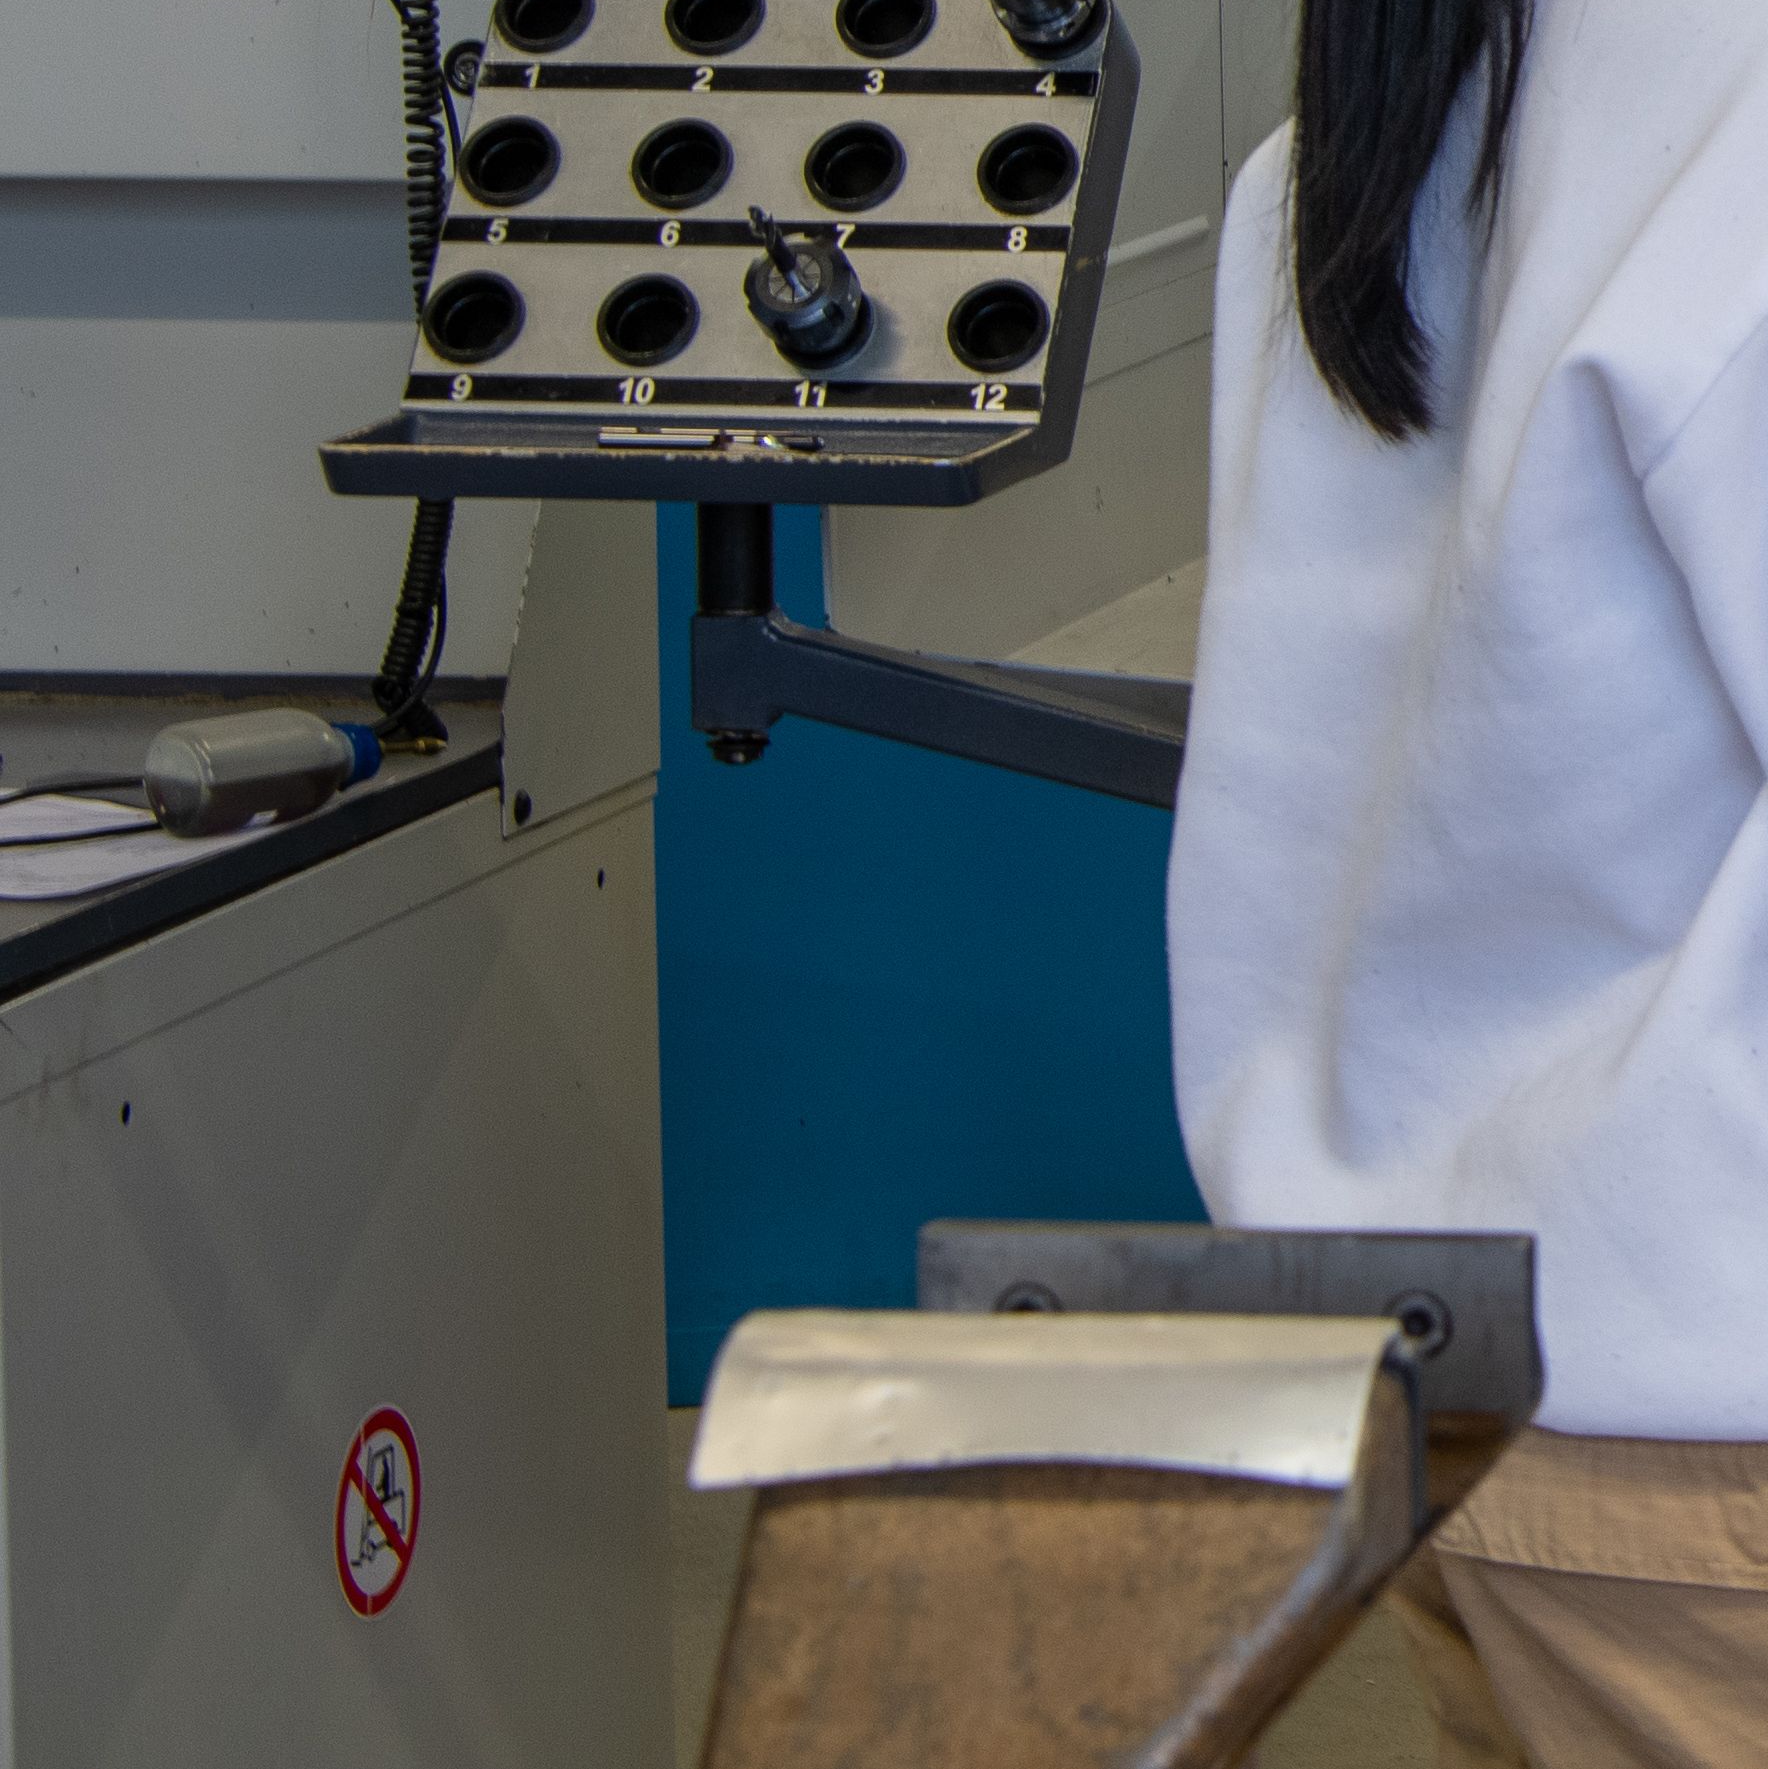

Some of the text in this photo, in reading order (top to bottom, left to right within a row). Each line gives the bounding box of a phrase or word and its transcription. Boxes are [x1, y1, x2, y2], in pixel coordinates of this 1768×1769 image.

[523, 64, 1056, 97] 1 2 3 4
[487, 218, 1028, 253] 5 6 7 8
[451, 374, 1007, 412] 9 10 11 12
